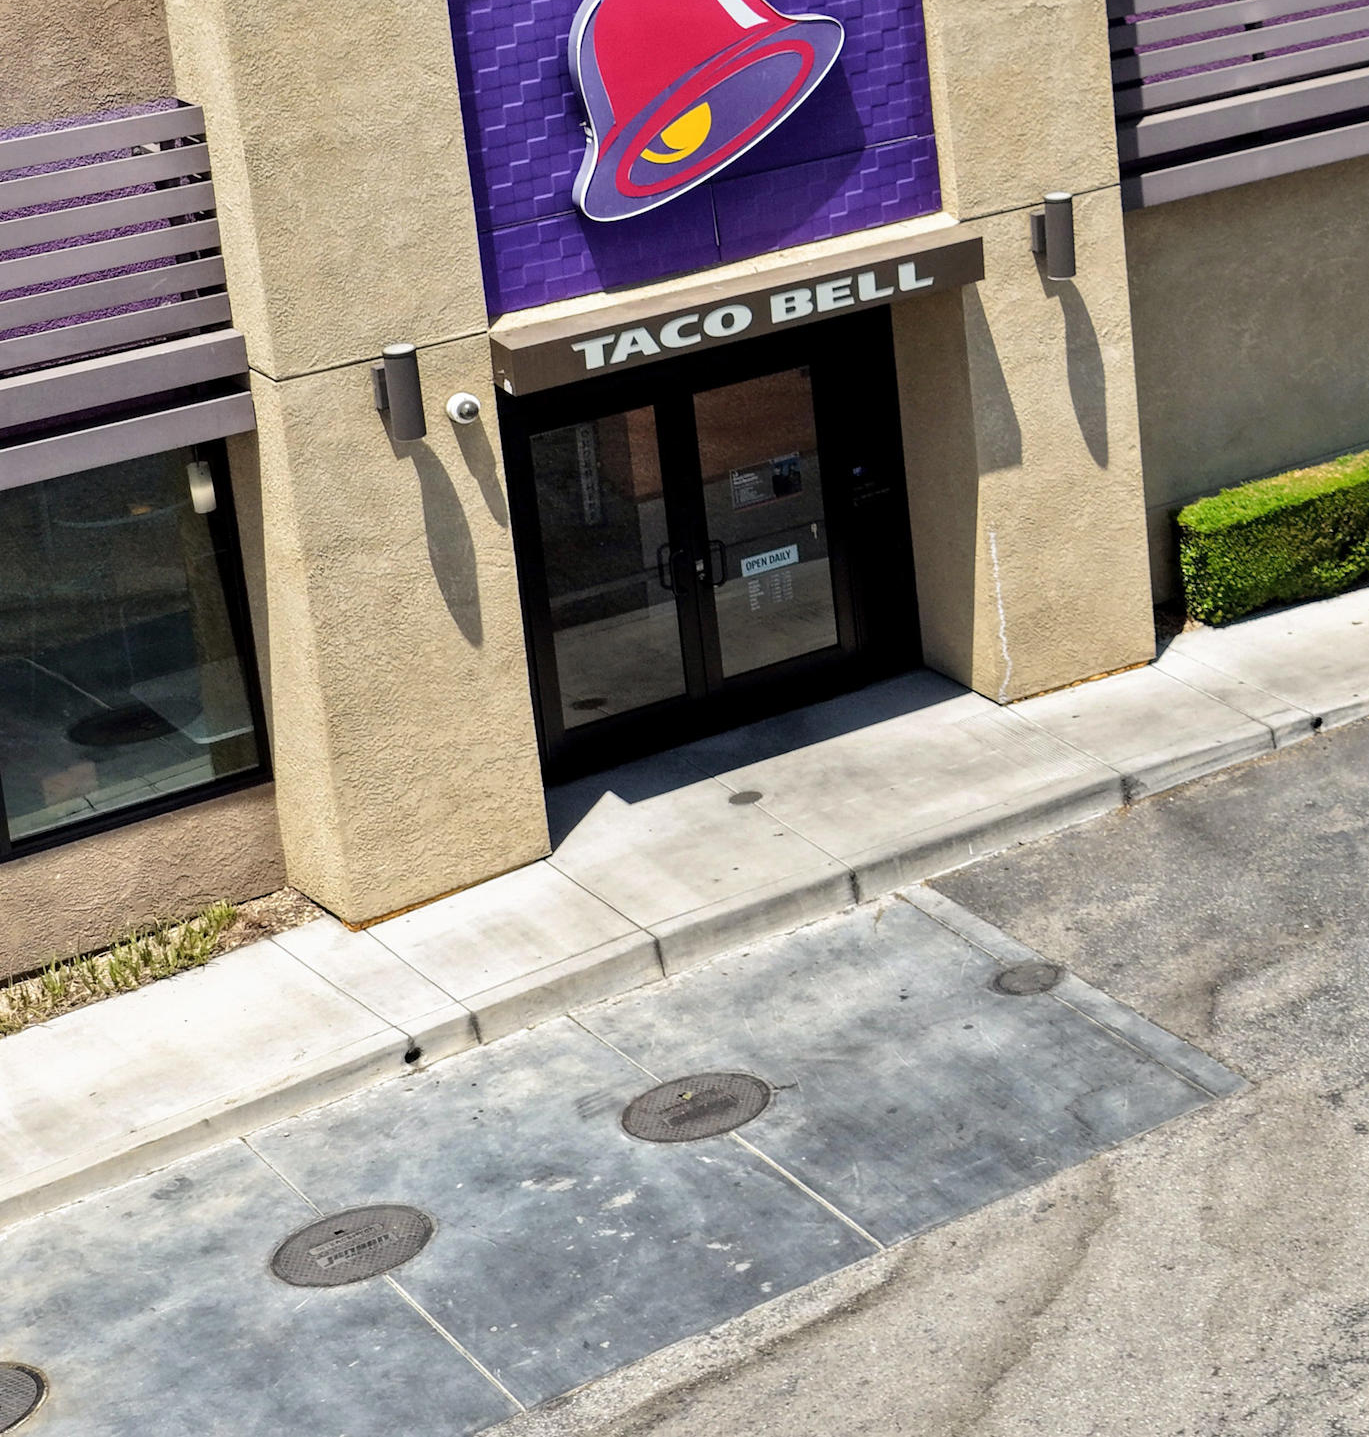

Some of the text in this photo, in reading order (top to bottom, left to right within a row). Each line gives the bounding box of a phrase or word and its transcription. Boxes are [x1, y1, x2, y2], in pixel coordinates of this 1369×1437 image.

[572, 263, 933, 369] TACO BELL
[745, 549, 790, 571] OPEN DAILY
